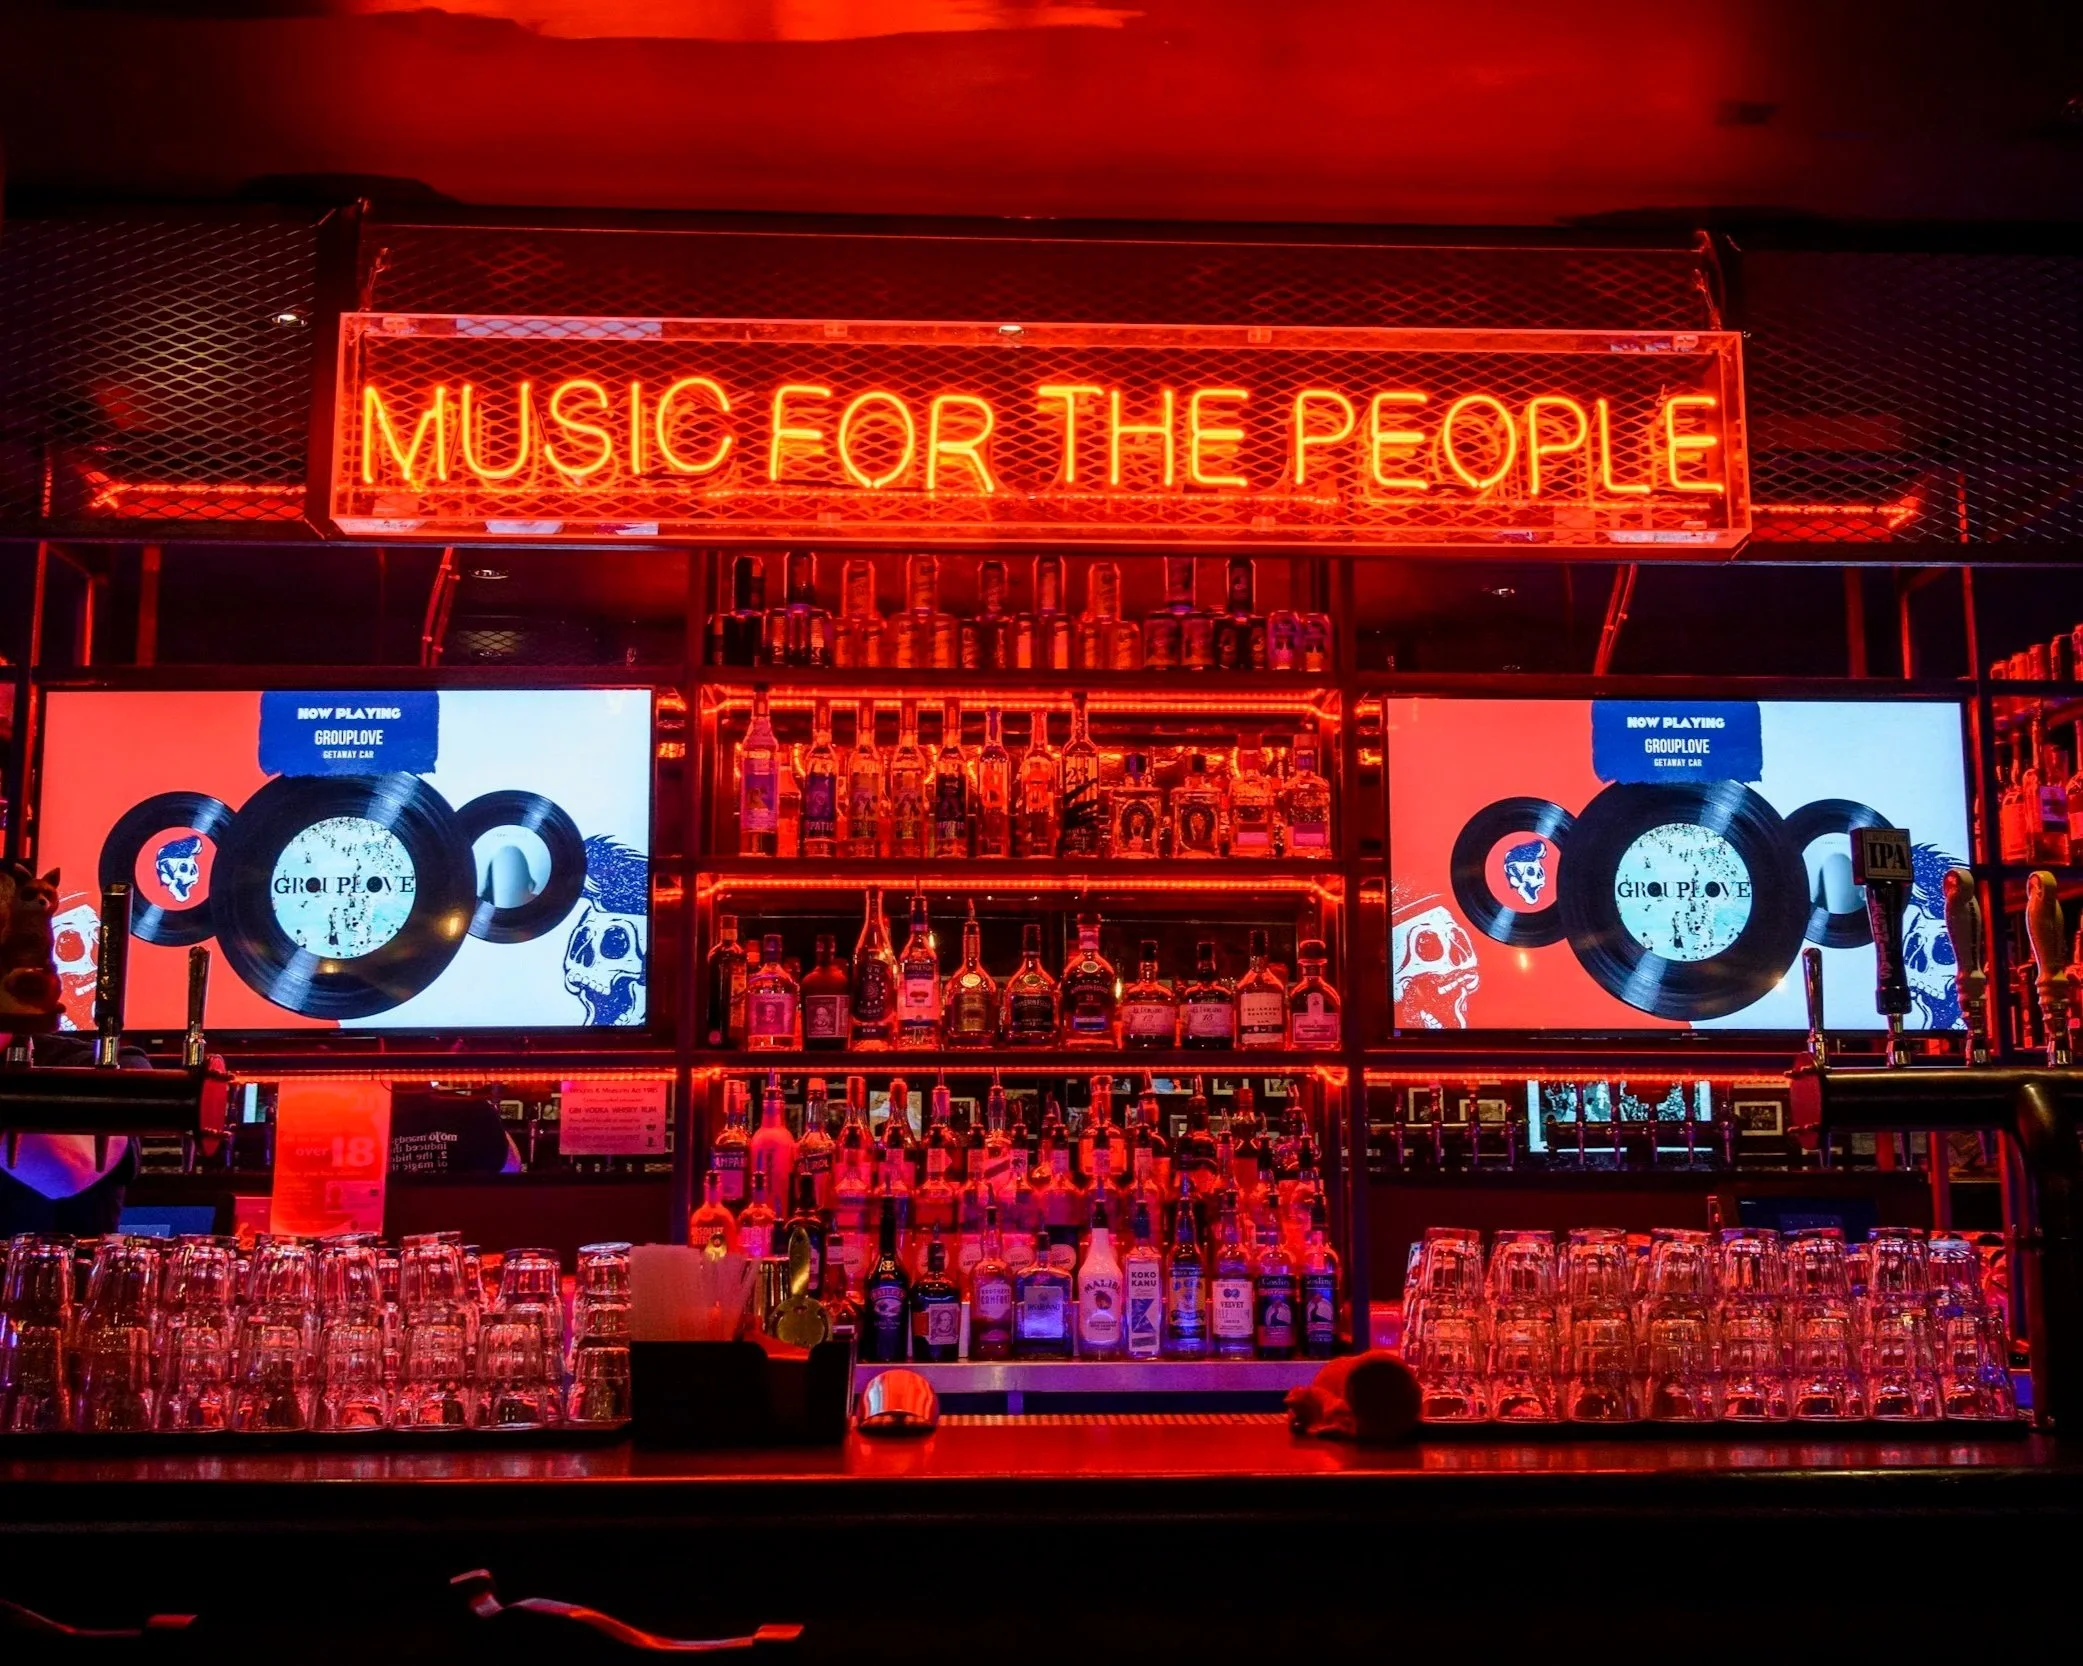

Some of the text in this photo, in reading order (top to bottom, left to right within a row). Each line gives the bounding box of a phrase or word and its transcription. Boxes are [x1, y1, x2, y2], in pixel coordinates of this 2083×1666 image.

[362, 377, 1726, 496] MUSIC FOR THE PEOPLE
[297, 707, 402, 720] NOW PLAYING
[1626, 716, 1726, 729] NOW PLAYING
[314, 729, 385, 746] GROUPLOVE
[1644, 738, 1711, 754] GROUPLOVE
[323, 750, 375, 759] GETAWAY CAR
[1653, 758, 1703, 767] GETAWAY CAR
[1867, 842, 1908, 870] IPA
[274, 875, 415, 894] GROUPLOVE
[1617, 880, 1751, 898] GROUPLOVE
[295, 1146, 329, 1156] over
[331, 1135, 375, 1168] 18
[1131, 1271, 1157, 1279] KOKO
[980, 1295, 1011, 1306] COMFORT
[1219, 1300, 1245, 1309] VELVET
